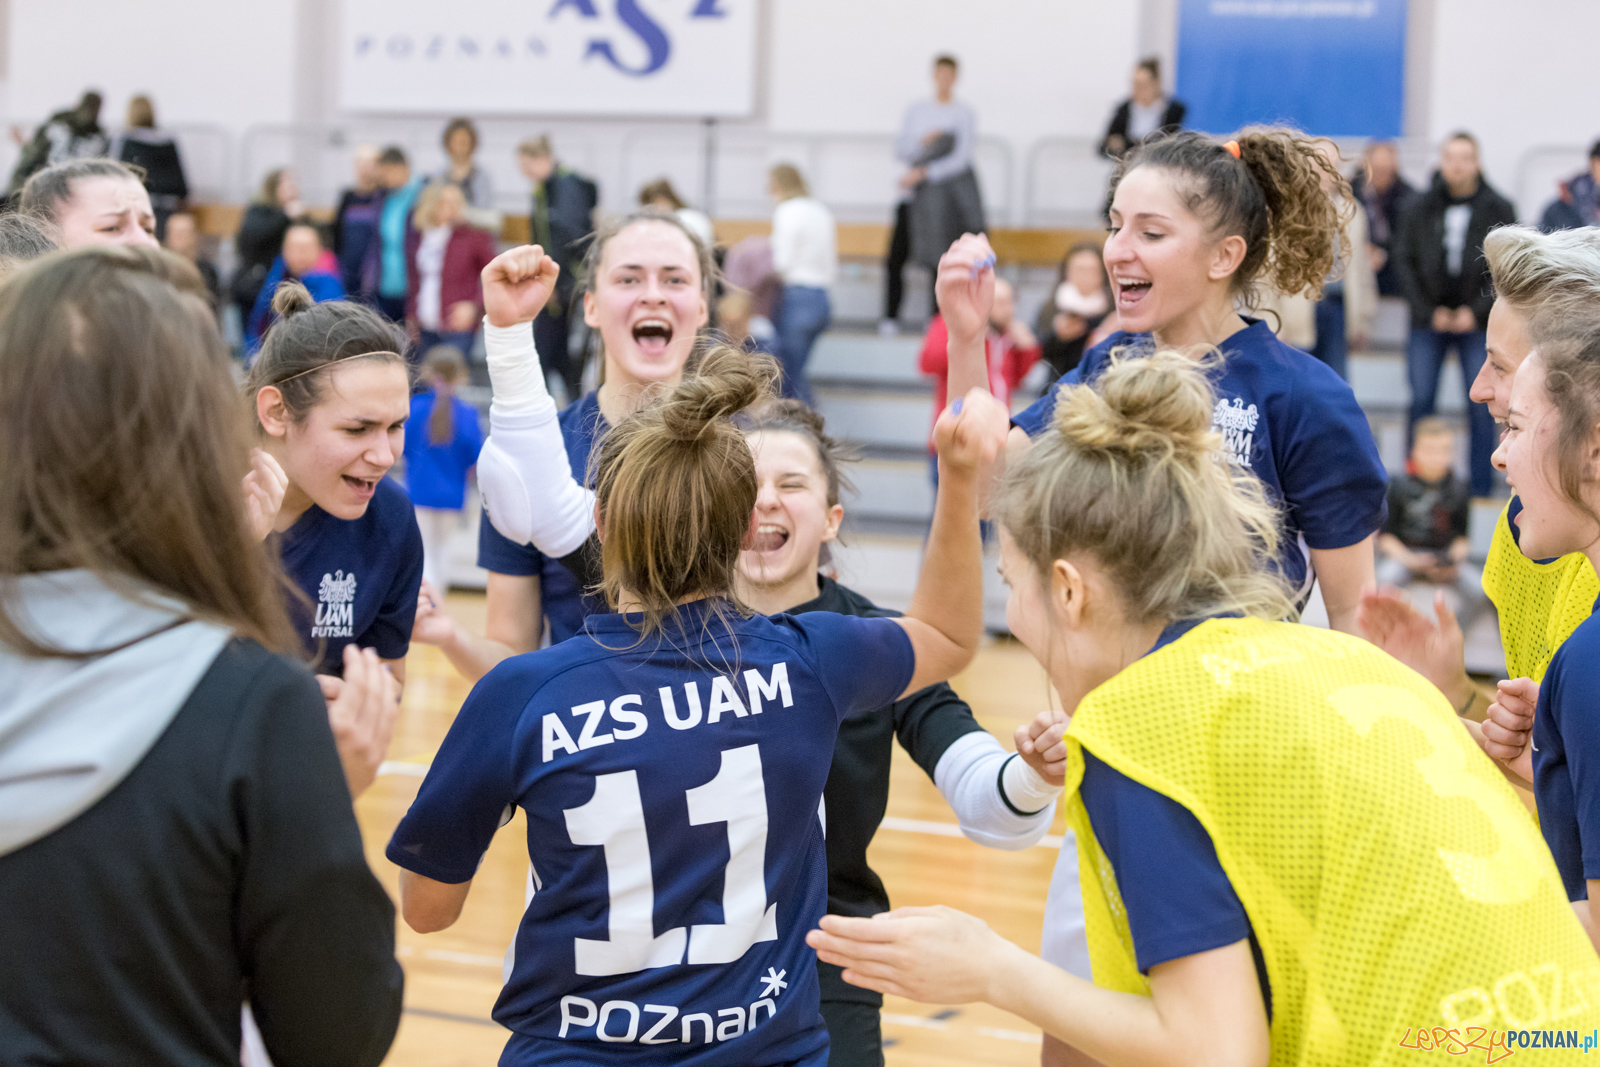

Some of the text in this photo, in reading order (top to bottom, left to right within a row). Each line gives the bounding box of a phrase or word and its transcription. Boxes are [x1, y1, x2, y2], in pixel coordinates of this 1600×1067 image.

[311, 626, 354, 638] FUTSAL
[315, 602, 354, 626] UAM
[542, 662, 794, 763] AZS UAM
[1328, 684, 1545, 905] 3
[562, 743, 779, 977] 11
